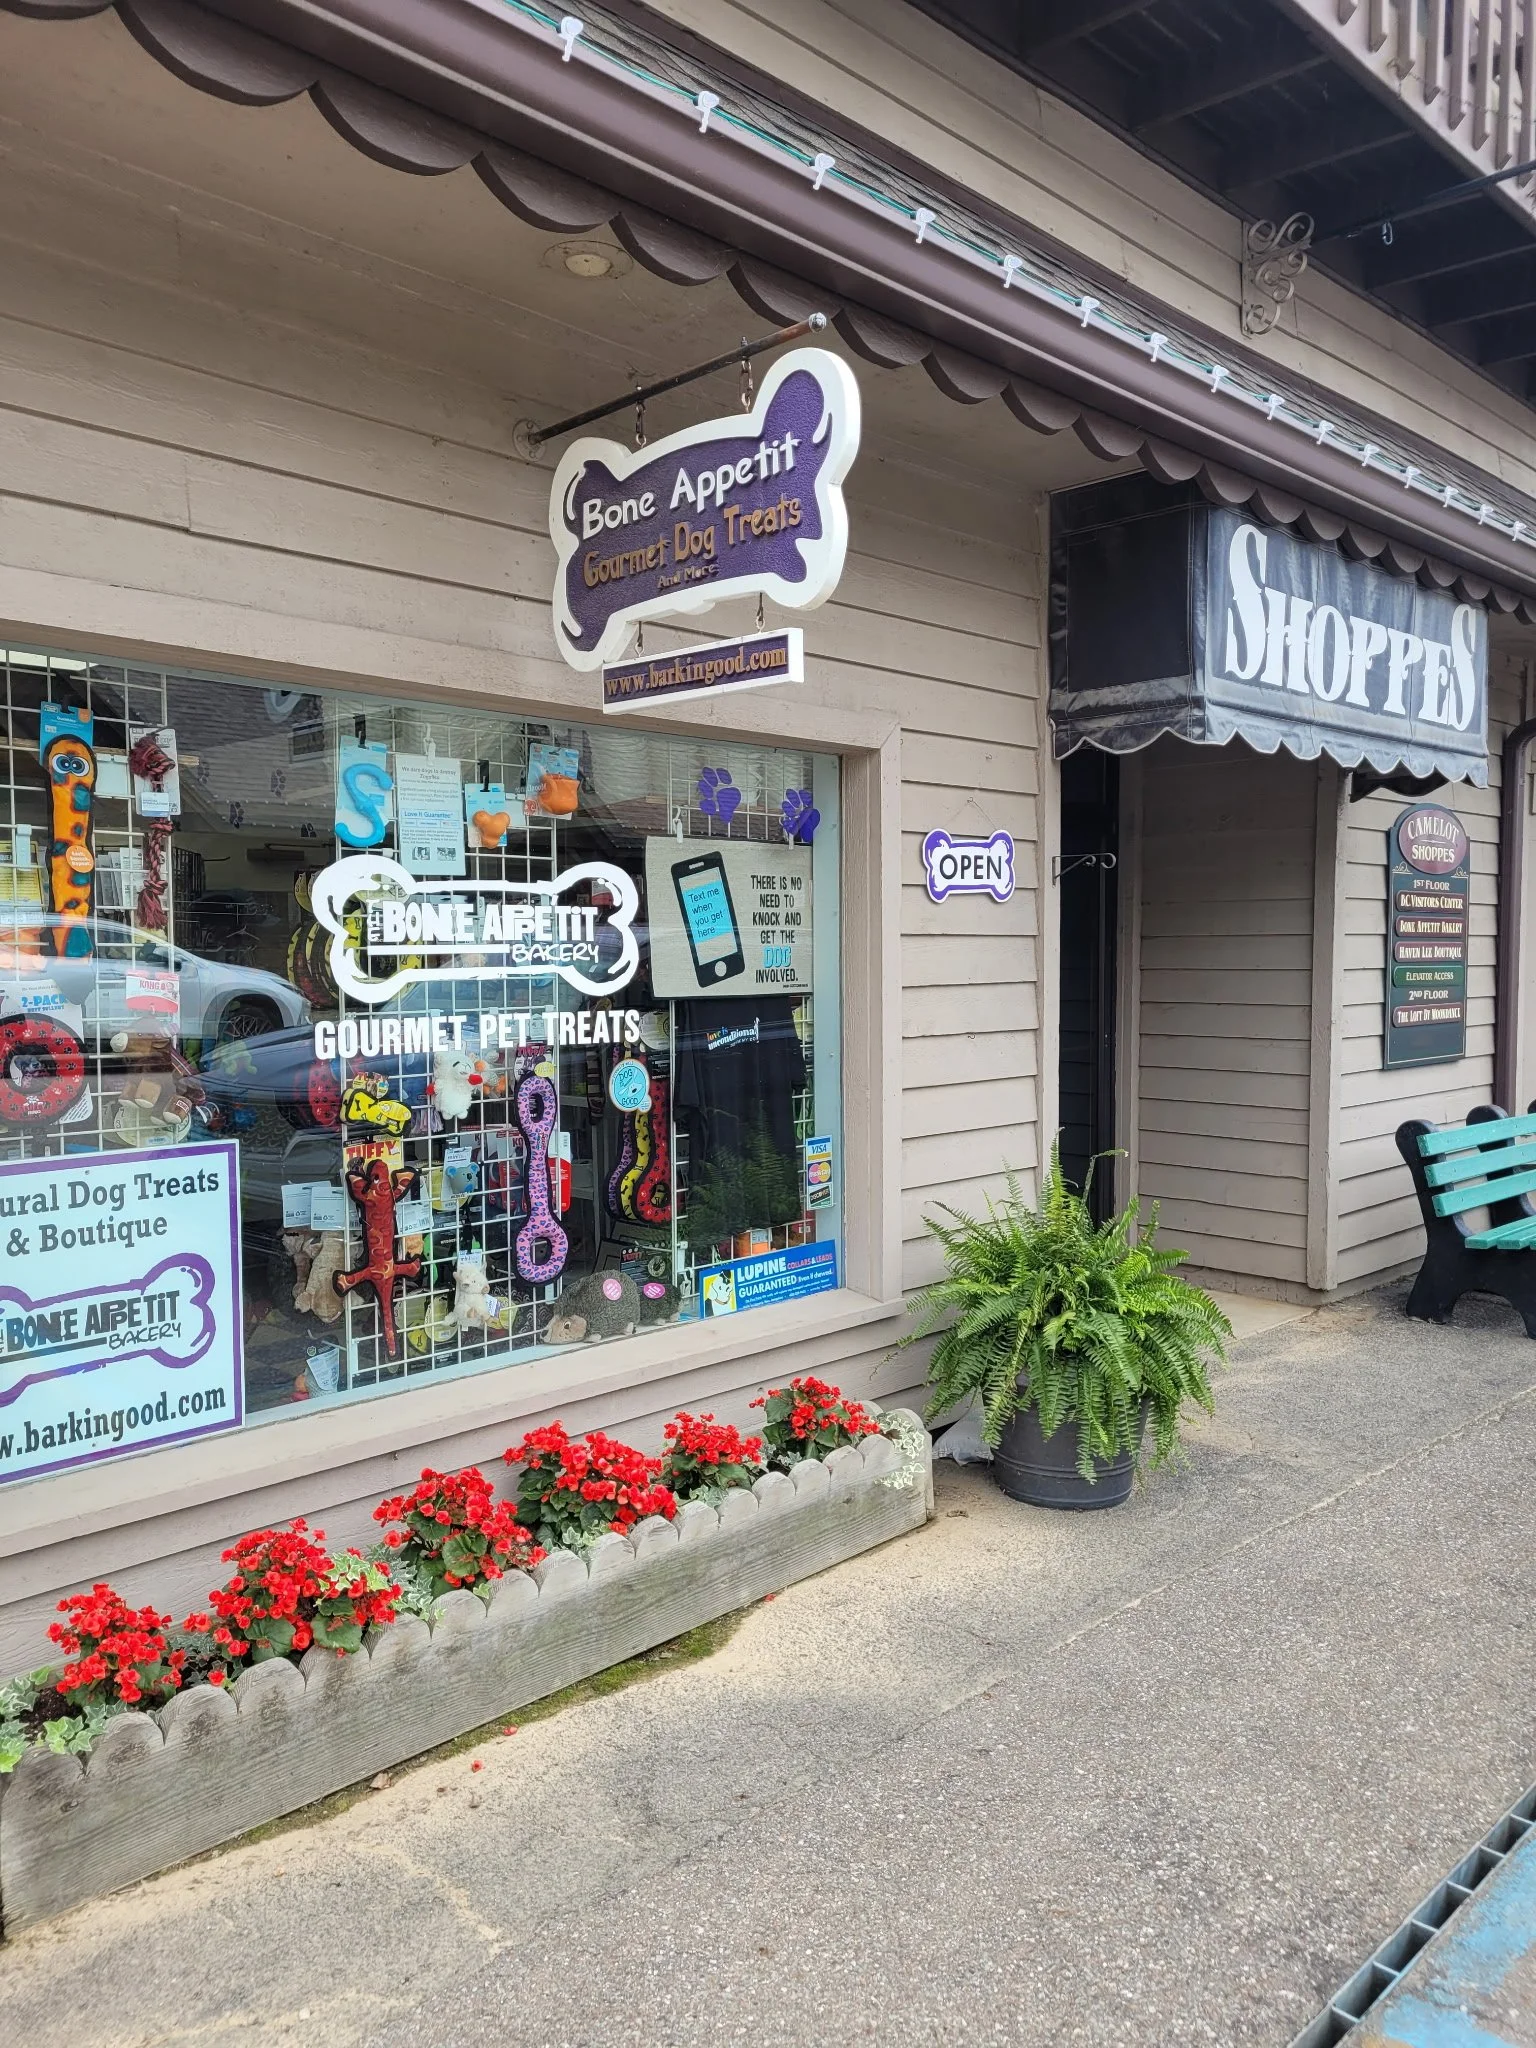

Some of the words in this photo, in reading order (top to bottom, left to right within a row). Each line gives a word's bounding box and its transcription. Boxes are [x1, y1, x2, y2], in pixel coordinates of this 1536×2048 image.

[583, 491, 656, 540] Bone
[669, 431, 801, 513] Appetit
[583, 535, 671, 587] Gourmet
[674, 521, 718, 561] Dog
[723, 493, 802, 545] Treats
[657, 570, 680, 589] And
[683, 563, 718, 582] More
[1225, 523, 1477, 731] SHOPPES
[605, 646, 787, 697] www.barkingood.com
[1407, 816, 1459, 844] CAMELOT
[1412, 845, 1455, 863] SHOPPES
[940, 854, 1001, 879] OPEN
[751, 875, 776, 890] THERE
[779, 876, 788, 890] IS
[790, 876, 802, 890] NO
[1413, 879, 1425, 888] 1ST
[1425, 880, 1450, 891] FLOOR
[688, 890, 706, 903] Text
[707, 887, 720, 897] me
[759, 894, 780, 908] NEED
[784, 894, 795, 907] TO
[1440, 896, 1463, 909] CENTER
[692, 901, 713, 914] when
[383, 900, 474, 942] BONE
[695, 915, 710, 928] you
[711, 909, 724, 924] get
[752, 912, 780, 926] KNOCK
[784, 912, 801, 926] AND
[1400, 920, 1416, 933] BONE
[1417, 921, 1440, 933] APPETIT
[1441, 921, 1463, 933] BAKERY
[698, 926, 716, 938] here
[760, 930, 777, 944] GET
[780, 930, 796, 944] THE
[512, 942, 600, 964] BAKERY
[763, 946, 792, 968] DOG
[1399, 946, 1420, 959] HAVEN
[1434, 946, 1461, 960] BOUTIQUE
[756, 968, 799, 983] INVOLVED.
[1406, 972, 1433, 981] ELEVATOR
[1434, 971, 1454, 980] ACCESS
[139, 980, 160, 990] KONG
[1408, 990, 1422, 1000] 2ND
[1423, 990, 1449, 999] FLOOR
[1397, 1011, 1409, 1023] THE
[1410, 1010, 1423, 1022] LOFT
[1424, 1008, 1431, 1020] BY
[1431, 1007, 1461, 1020] MOONDANCE
[314, 1015, 468, 1060] GOURMET
[480, 1011, 531, 1050] PET
[545, 1009, 641, 1047] TREATS
[721, 1026, 729, 1036] is
[619, 1068, 633, 1080] DOG
[621, 1097, 639, 1106] GOOD
[346, 1140, 397, 1159] TUFFY
[812, 1144, 827, 1154] VISA
[67, 1181, 126, 1212] Dog
[134, 1168, 219, 1200] Treats
[6, 1227, 30, 1257] &
[39, 1215, 168, 1252] Boutique
[737, 1257, 787, 1283] LUPINE
[787, 1258, 811, 1270] COLLARS
[816, 1253, 833, 1262] LEADS
[738, 1275, 797, 1298] GUARANTEED
[814, 1268, 834, 1279] chewed.
[5, 1308, 78, 1352] BONE
[108, 1322, 181, 1350] BAKERY
